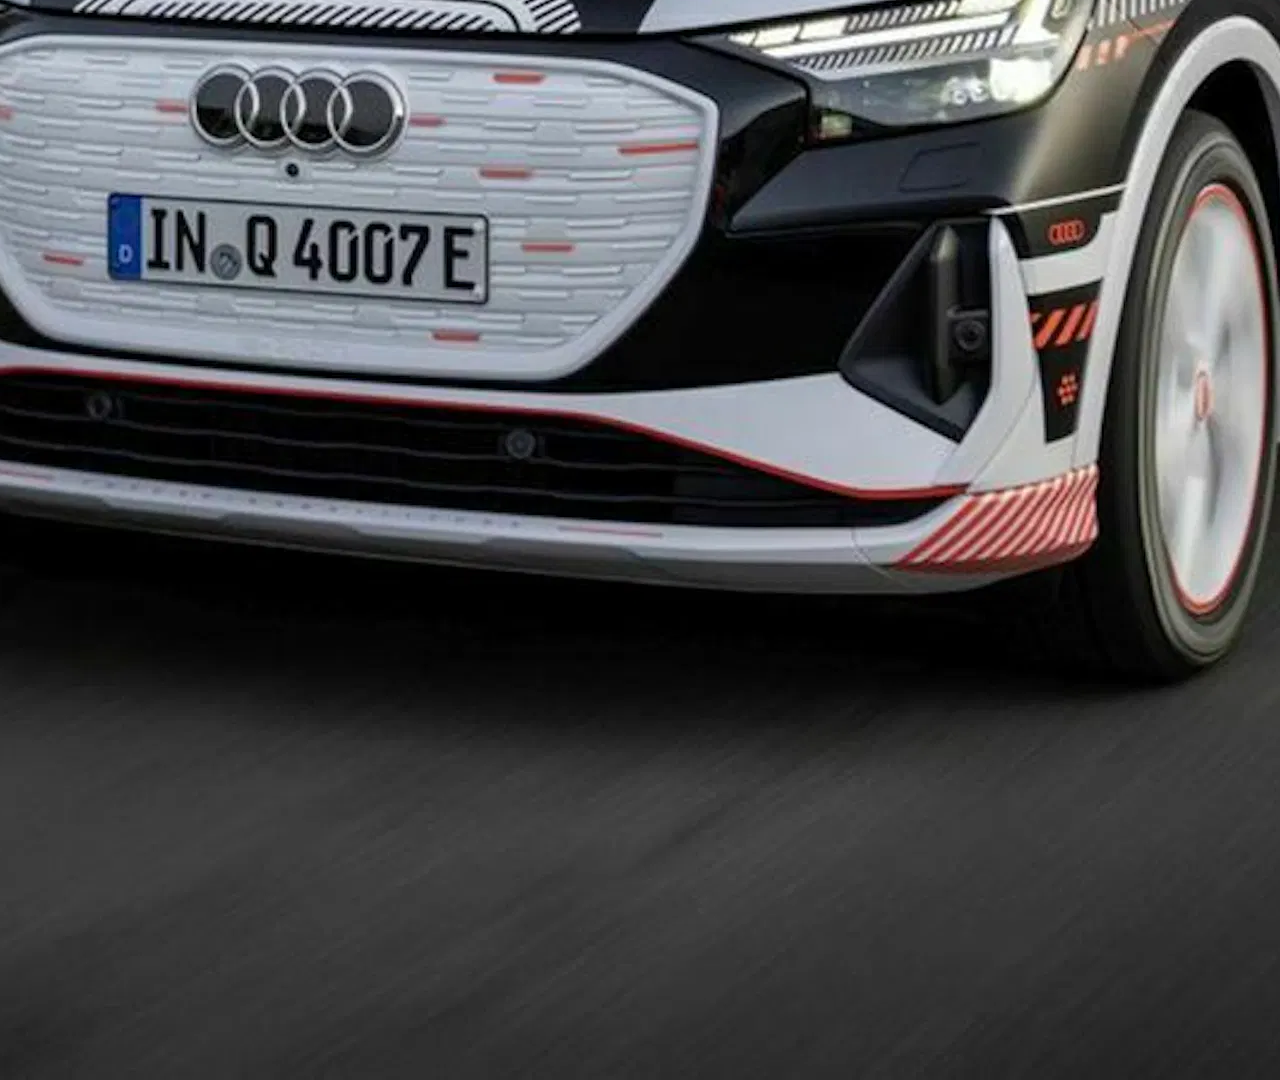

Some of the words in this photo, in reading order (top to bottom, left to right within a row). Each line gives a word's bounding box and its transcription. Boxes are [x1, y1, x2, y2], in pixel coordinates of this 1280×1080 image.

[117, 243, 134, 264] D
[147, 208, 206, 273] IN
[246, 214, 278, 278] Q
